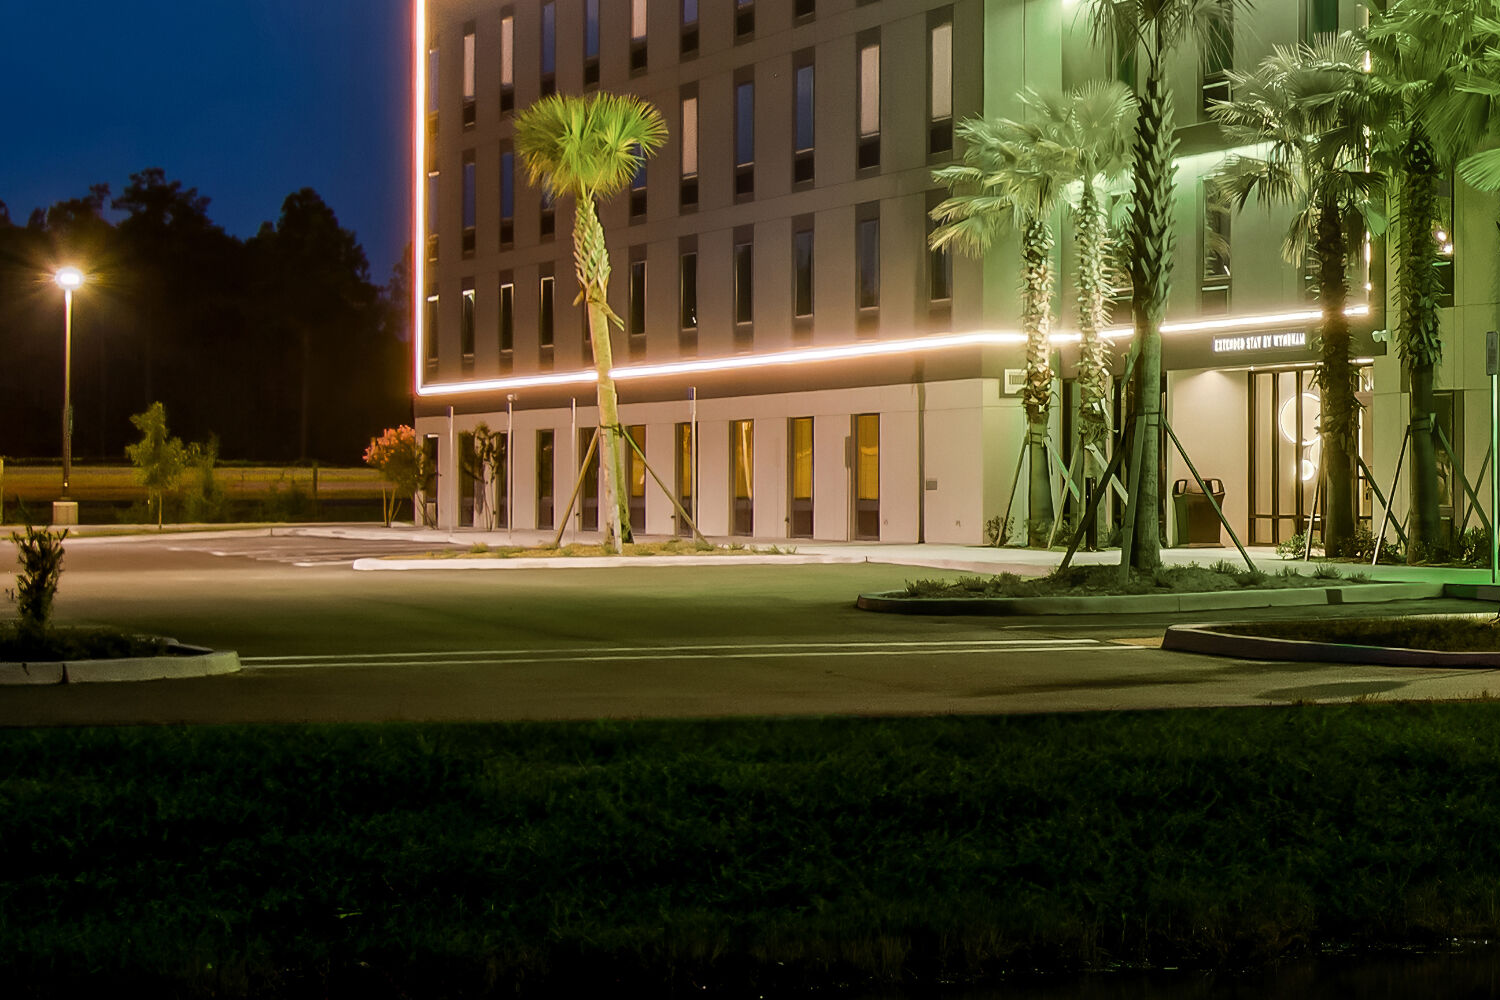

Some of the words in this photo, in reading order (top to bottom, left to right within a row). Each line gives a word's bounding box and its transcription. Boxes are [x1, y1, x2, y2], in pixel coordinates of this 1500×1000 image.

[1246, 336, 1262, 349] STAY
[1262, 334, 1272, 348] BY
[1273, 332, 1306, 346] WYNDHAM
